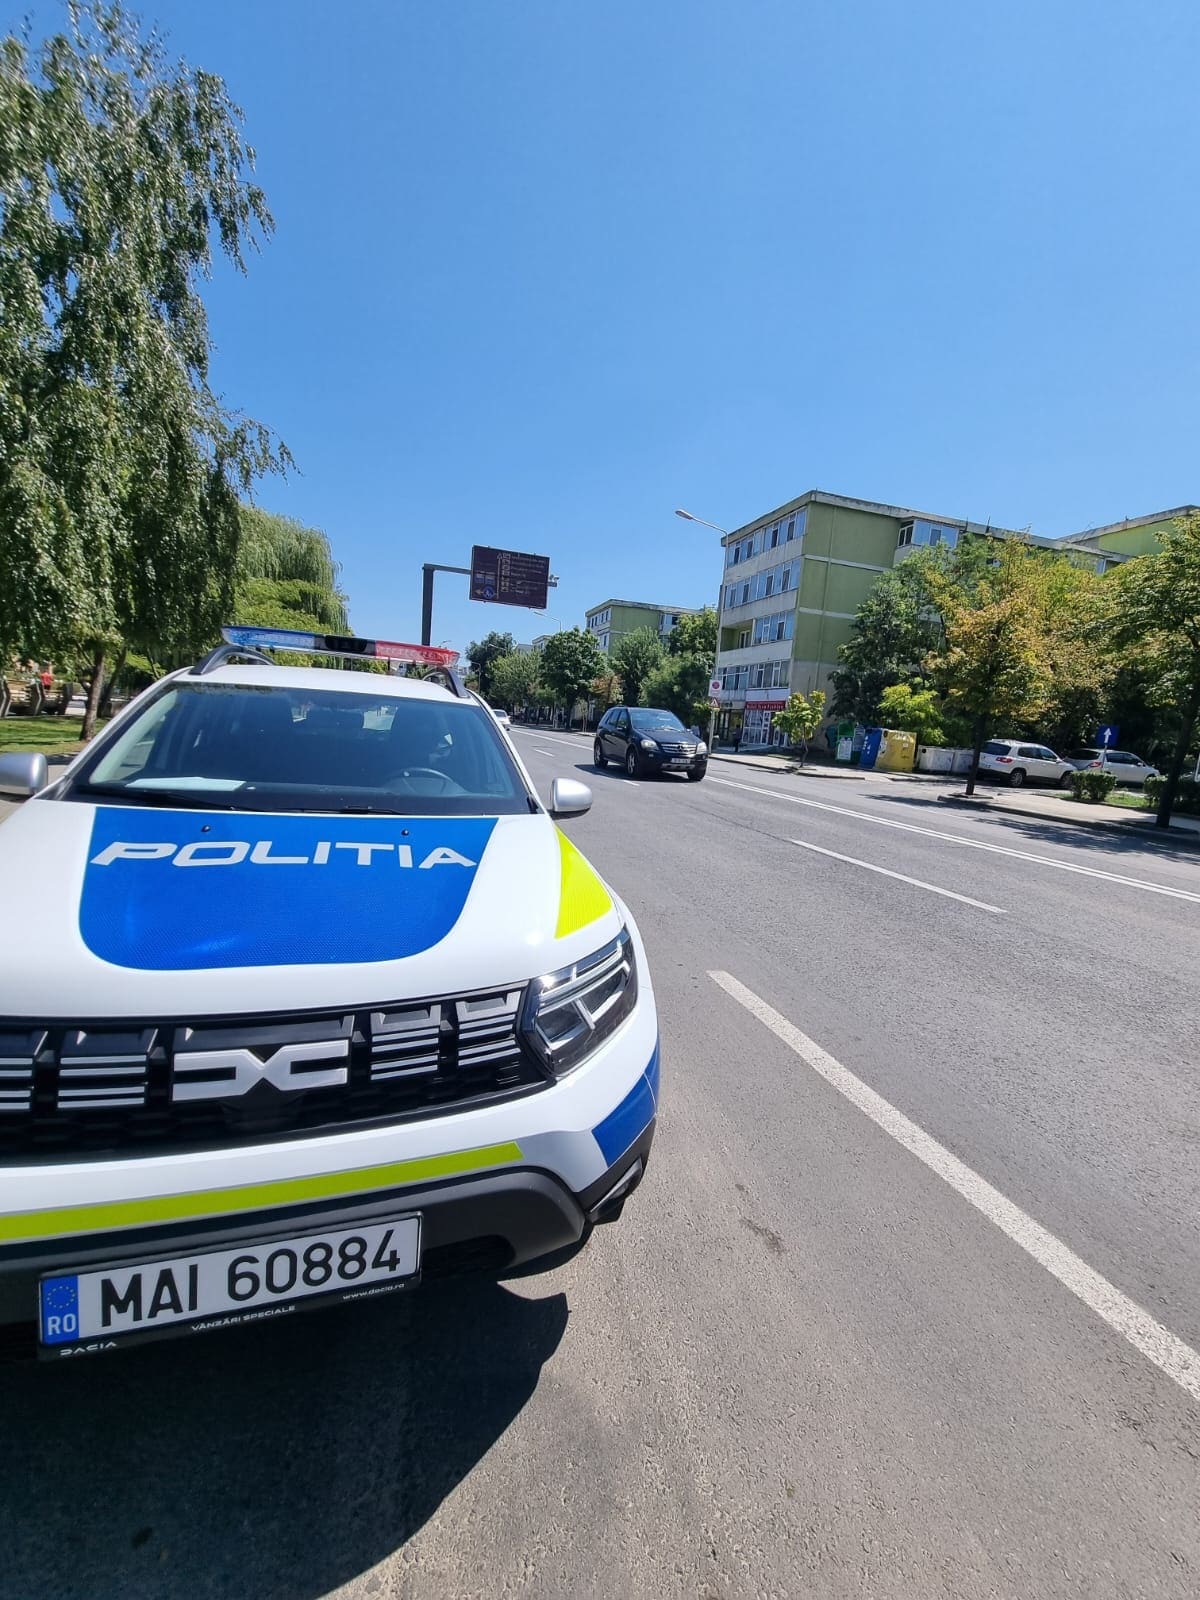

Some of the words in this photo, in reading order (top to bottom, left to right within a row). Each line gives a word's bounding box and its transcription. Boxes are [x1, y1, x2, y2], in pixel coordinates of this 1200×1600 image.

[90, 841, 478, 870] POLITIA
[100, 1263, 200, 1328] MAI
[226, 1229, 402, 1302] 60884
[342, 1283, 406, 1300] www.dacia.ro
[242, 1305, 296, 1321] SPECIALE
[47, 1312, 78, 1337] RO
[59, 1341, 118, 1357] DACIA
